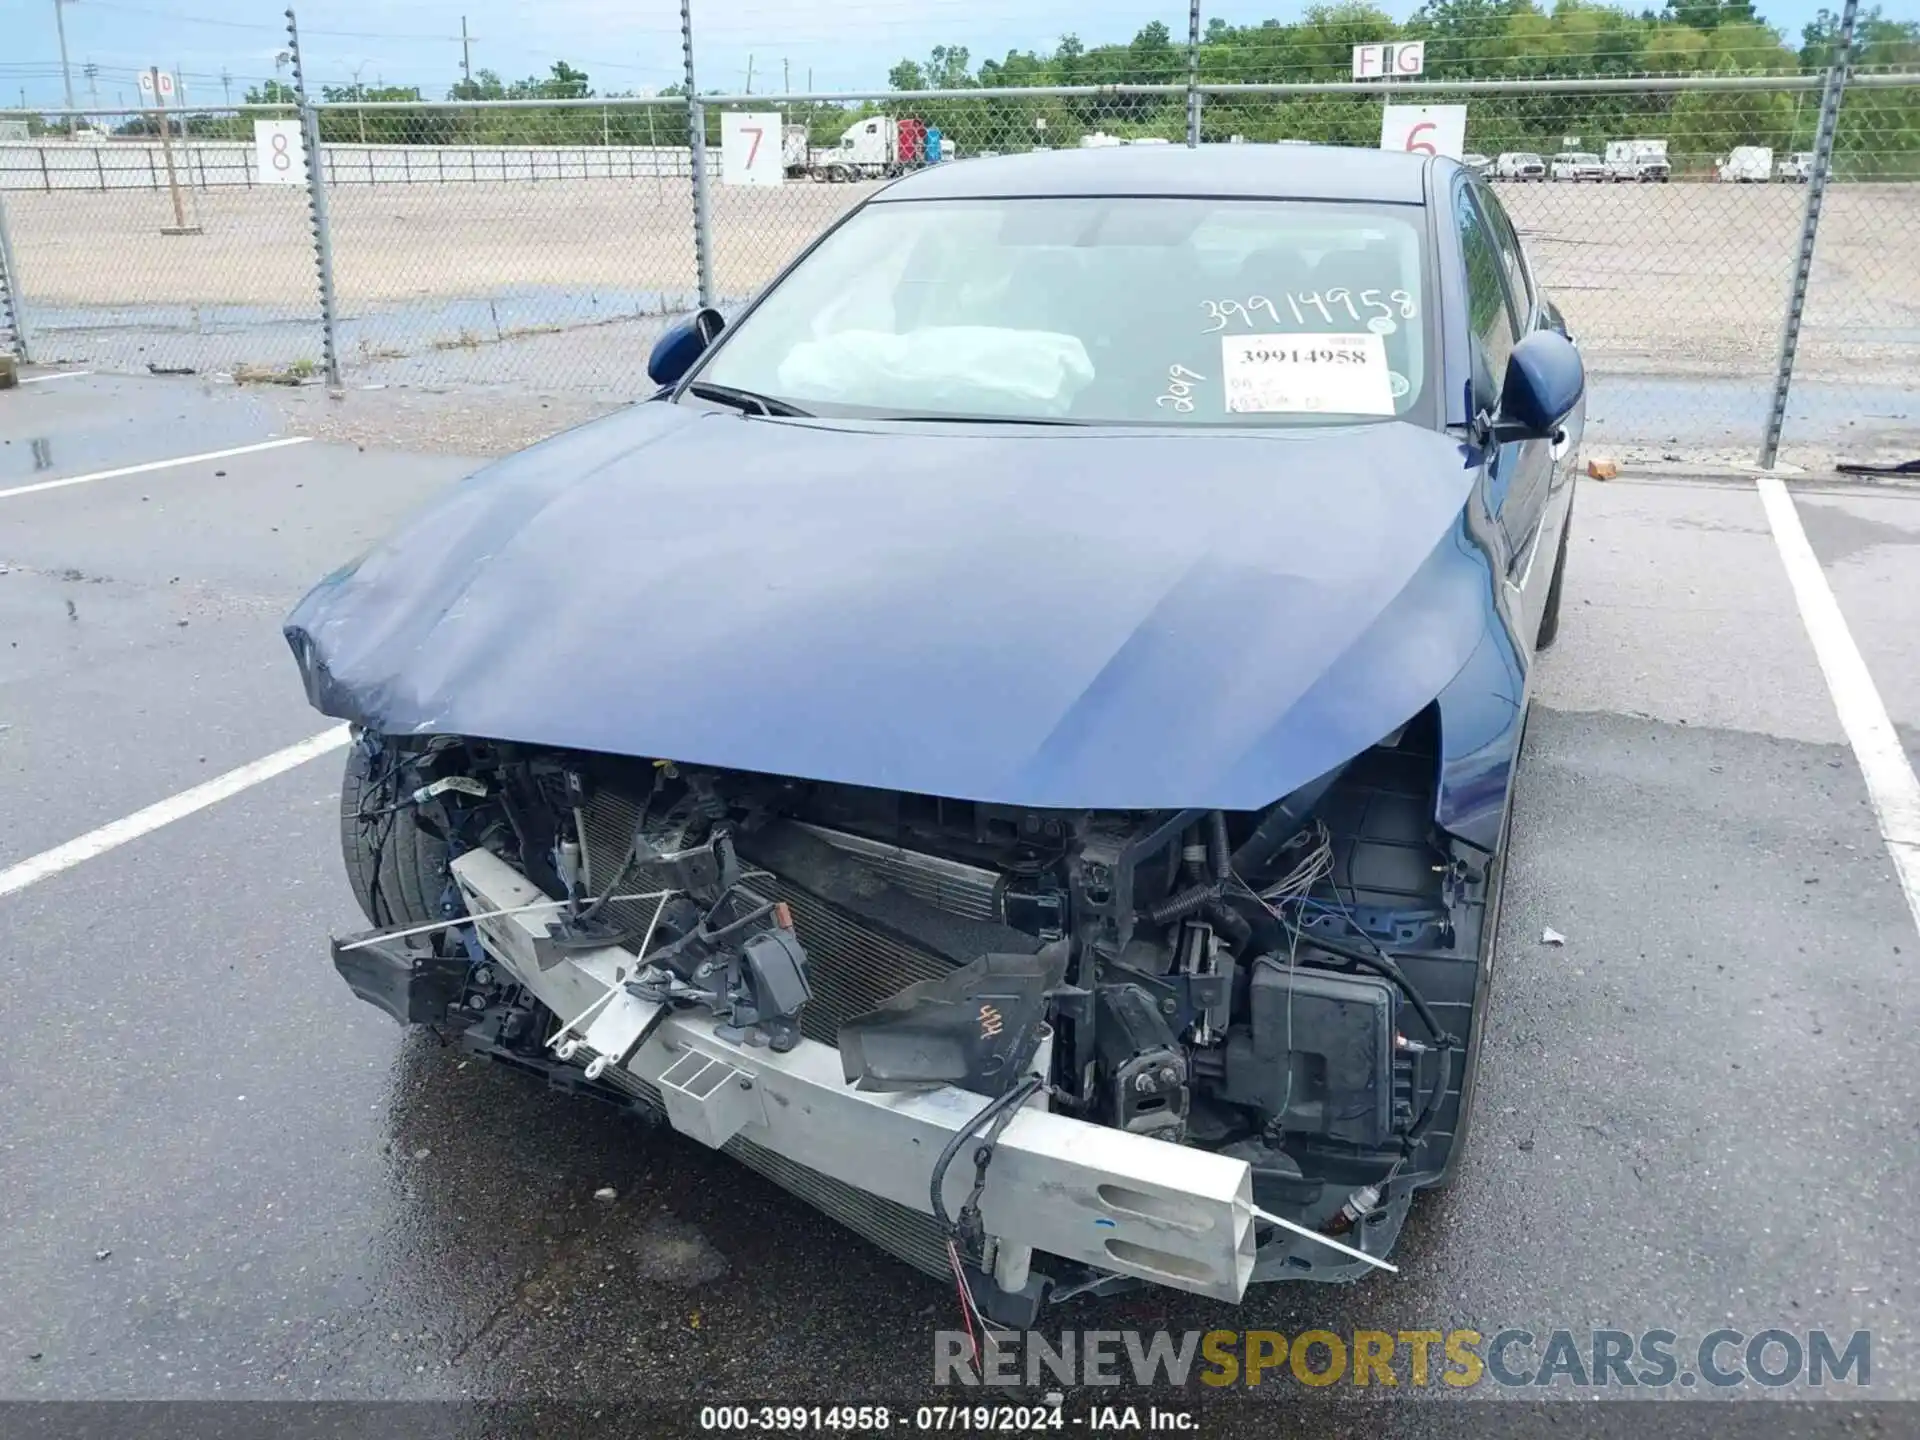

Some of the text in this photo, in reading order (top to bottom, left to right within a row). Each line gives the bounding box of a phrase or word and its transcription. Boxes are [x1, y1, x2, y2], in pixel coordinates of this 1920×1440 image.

[1360, 43, 1420, 76] F G
[271, 133, 291, 171] 8
[739, 127, 764, 170] 7
[1200, 287, 1416, 333] 39914958
[1240, 349, 1367, 365] 39914958
